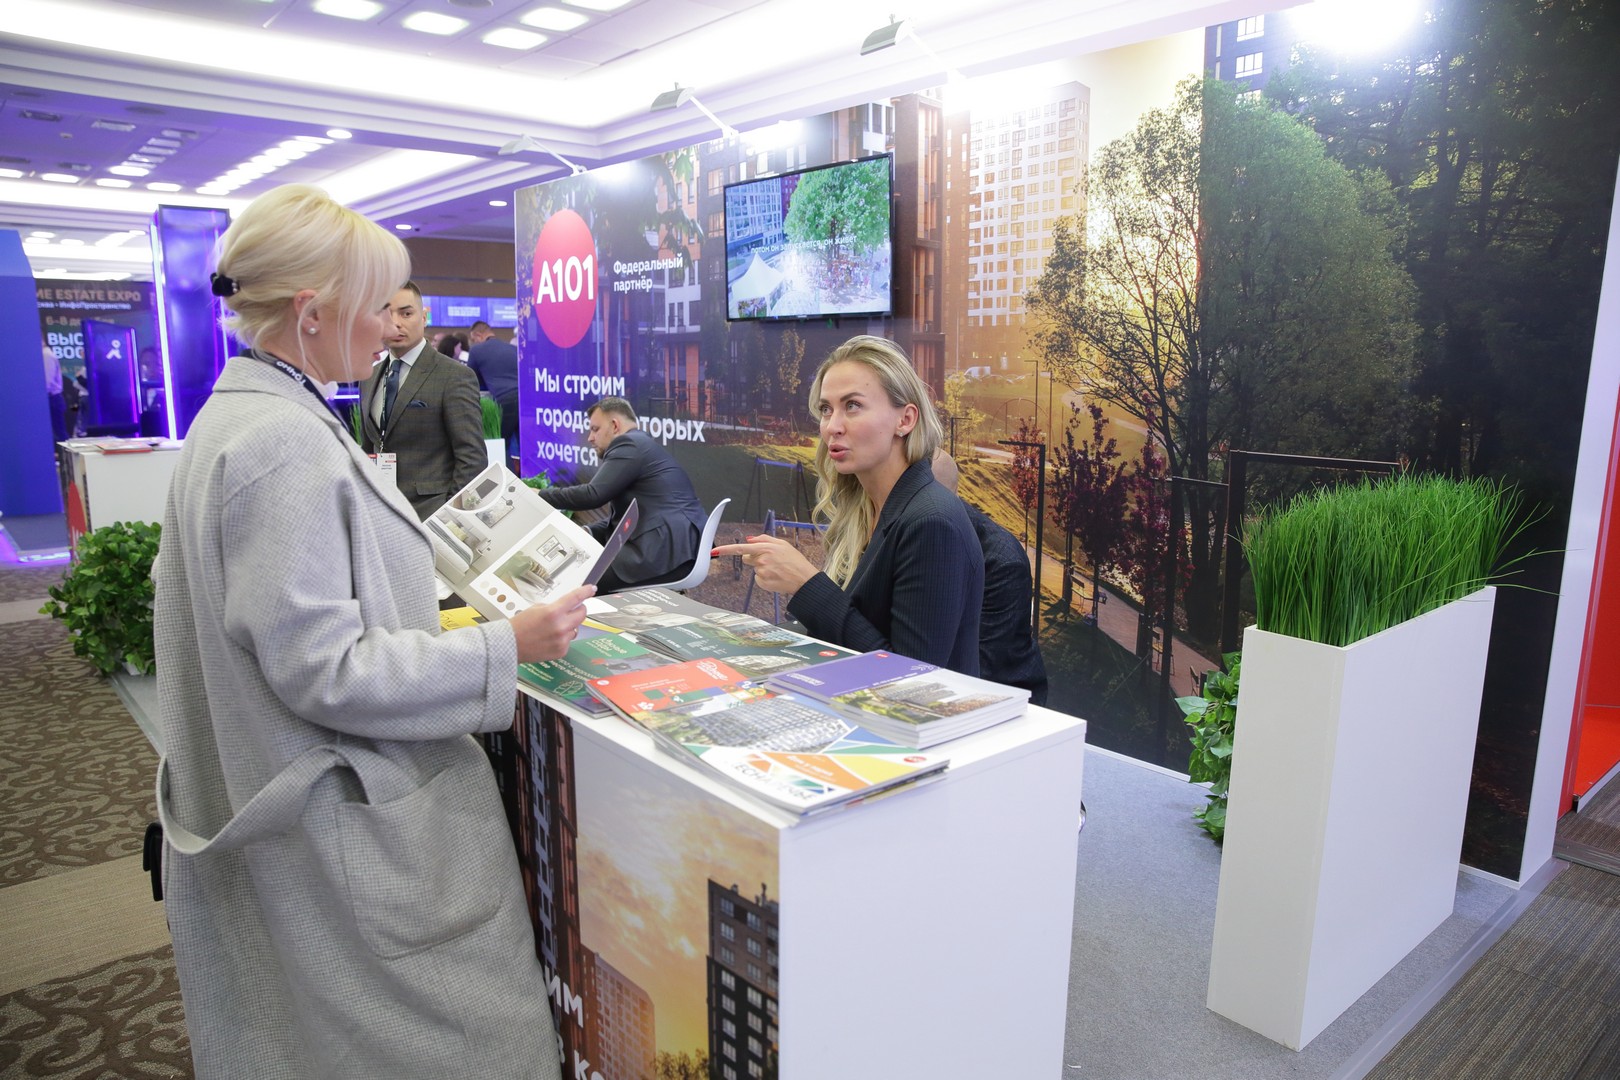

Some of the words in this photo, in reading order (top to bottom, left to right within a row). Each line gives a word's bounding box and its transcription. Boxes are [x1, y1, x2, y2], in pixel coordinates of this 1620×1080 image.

[613, 253, 683, 275] Федеральный
[55, 288, 105, 301] ESTATE
[107, 290, 142, 302] EXPO
[613, 276, 653, 294] партнёр
[535, 367, 560, 393] Мы
[563, 374, 625, 401] строим
[635, 416, 706, 446] торых
[536, 440, 599, 467] хочется
